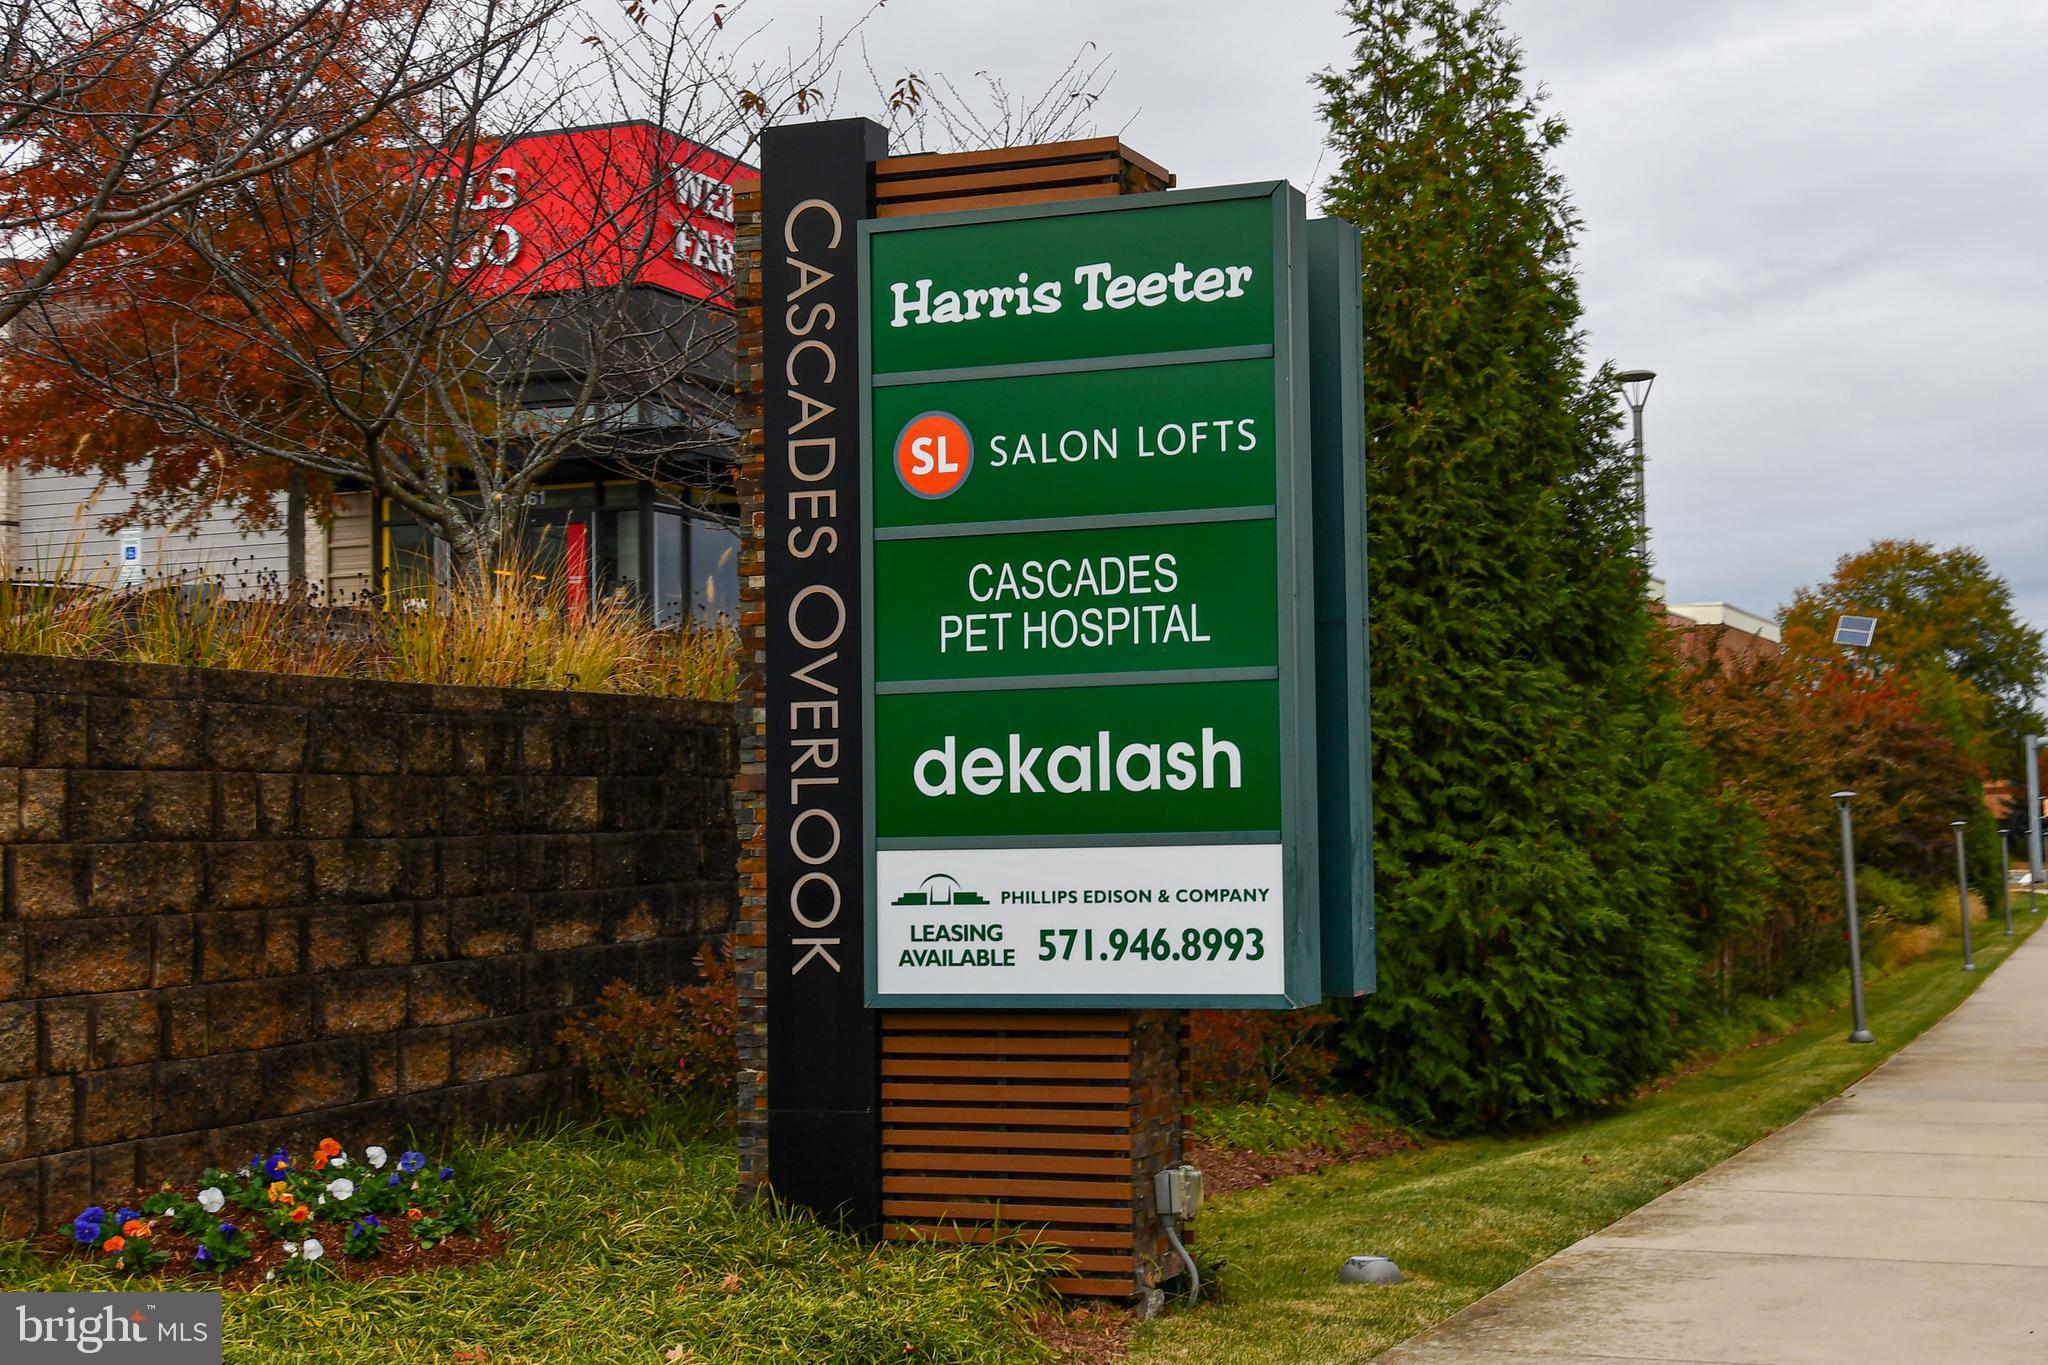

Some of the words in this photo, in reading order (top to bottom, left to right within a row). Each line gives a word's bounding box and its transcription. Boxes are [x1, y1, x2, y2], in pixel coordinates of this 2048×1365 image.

[671, 220, 736, 277] FAR
[890, 272, 1062, 328] Harris
[1074, 262, 1253, 312] Teeter
[784, 199, 843, 559] CASCADES
[911, 436, 959, 475] SL
[990, 427, 1118, 467] SALON
[1138, 418, 1257, 458] LOFTS
[968, 553, 1178, 602] CASCADES
[940, 612, 1012, 653] PET
[1023, 603, 1211, 650] HOSPITAL
[788, 584, 846, 975] OVERLOOK
[913, 727, 1242, 797] dekalash
[1001, 890, 1078, 905] PHILLIPS
[1083, 889, 1152, 904] EDISON
[1157, 889, 1170, 903] &
[1175, 888, 1270, 903] COMPANY
[910, 923, 1003, 943] LEASING
[1038, 927, 1265, 962] 571.946.8993
[898, 948, 1016, 968] AVAILABLE
